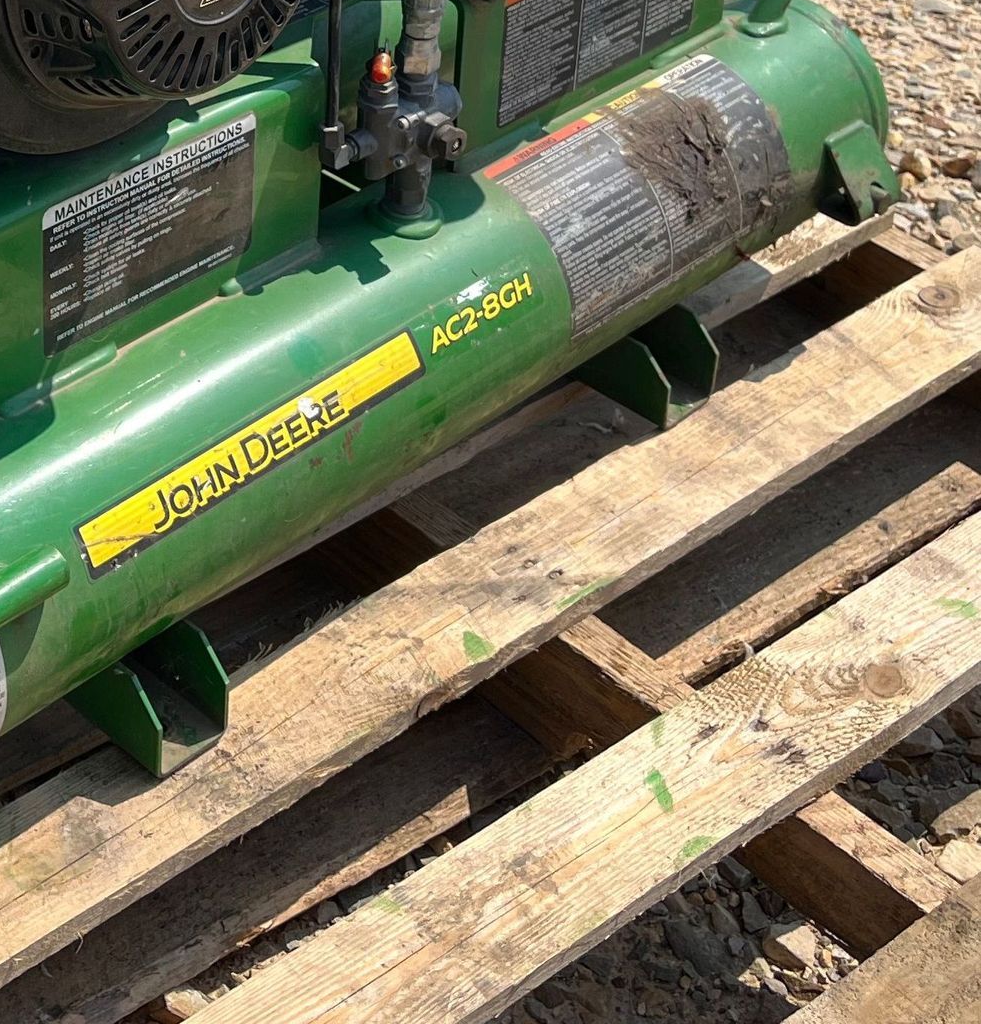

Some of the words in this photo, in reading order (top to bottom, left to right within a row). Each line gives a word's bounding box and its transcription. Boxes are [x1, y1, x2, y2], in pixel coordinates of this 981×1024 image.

[664, 58, 703, 80] OPERATION
[53, 218, 74, 234] REFER
[77, 212, 85, 222] TO
[86, 192, 128, 217] INSTRUCTION
[130, 178, 156, 196] MANUAL
[157, 171, 170, 183] FOR
[171, 157, 200, 176] DETAILED
[55, 166, 148, 222] MAINTENANCE
[153, 121, 242, 175] INSTRUCTIONS
[57, 326, 75, 341] REFER
[76, 323, 82, 331] TO
[84, 312, 102, 327] ENGINE
[105, 300, 126, 316] MANUAL
[127, 294, 138, 304] FOR
[139, 273, 178, 298] RECOMMENDED
[179, 262, 197, 277] ENGINE
[431, 272, 533, 354] AC2-8GH
[153, 453, 240, 531] JOHN
[240, 390, 347, 470] DEERE
